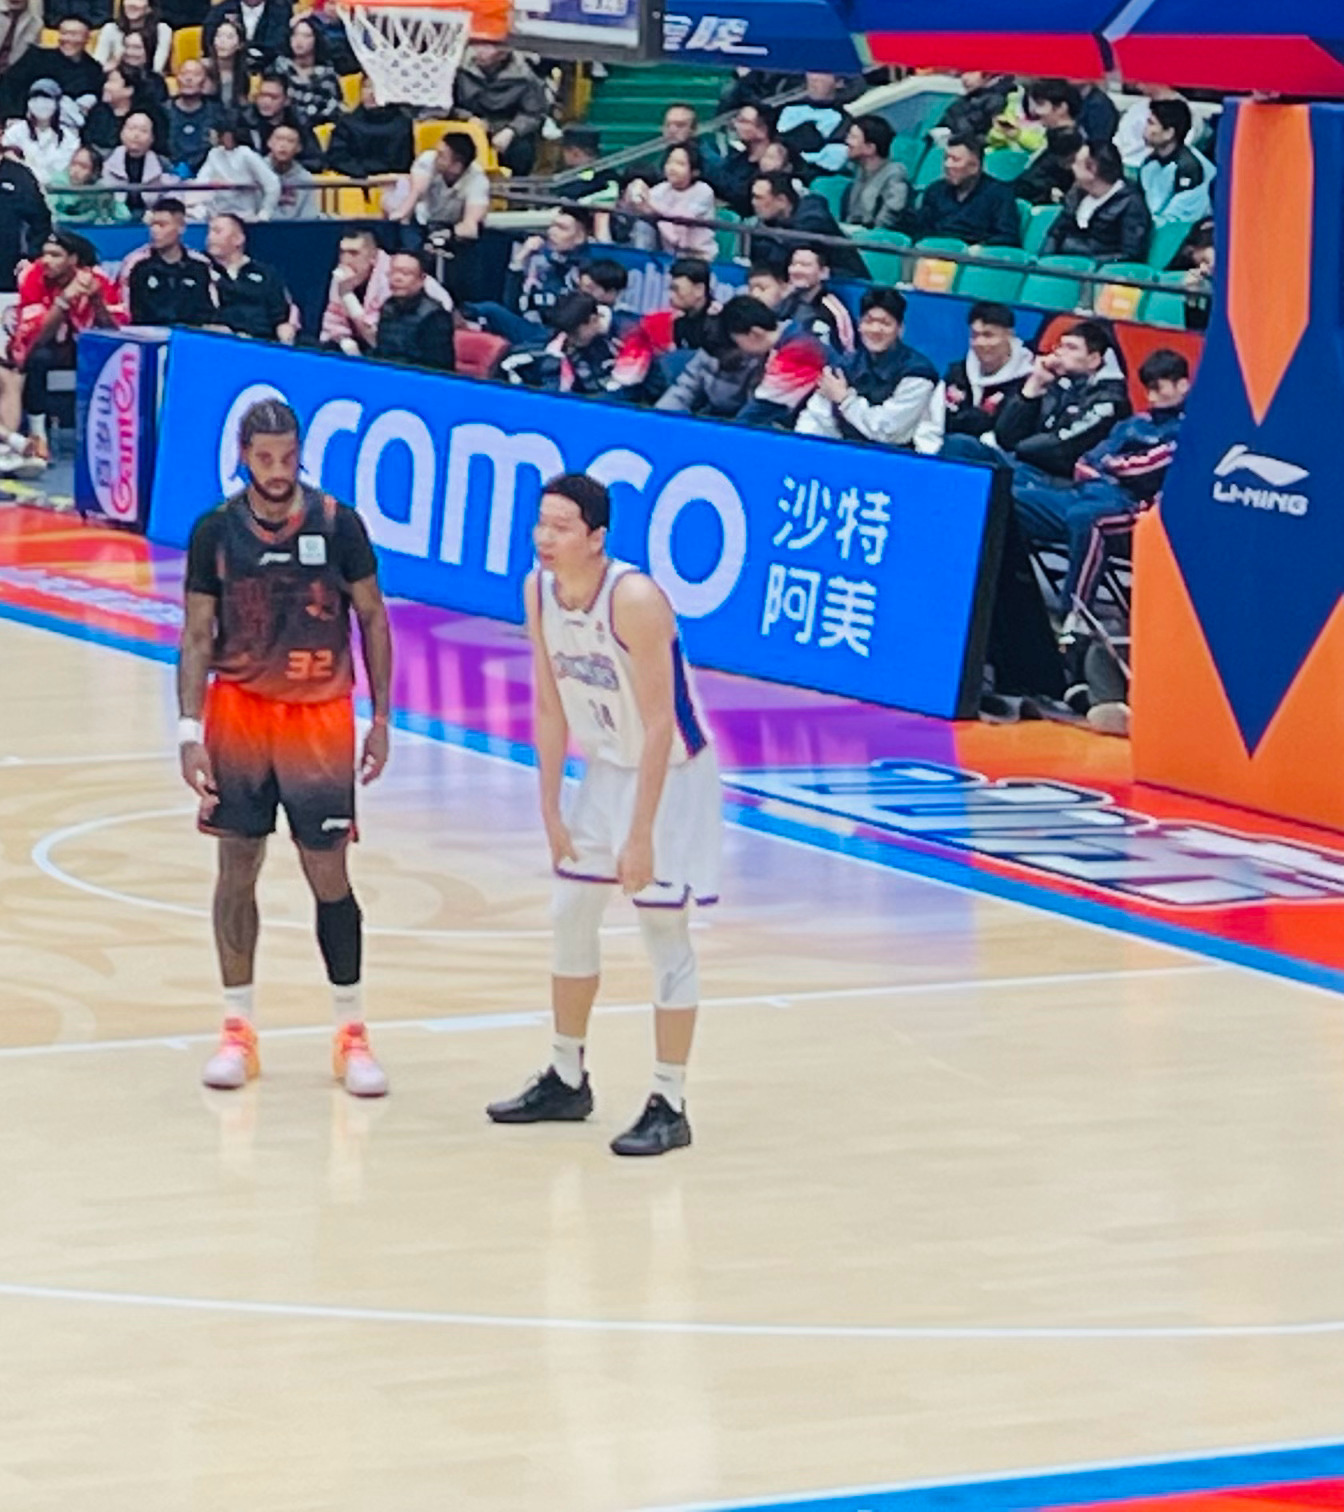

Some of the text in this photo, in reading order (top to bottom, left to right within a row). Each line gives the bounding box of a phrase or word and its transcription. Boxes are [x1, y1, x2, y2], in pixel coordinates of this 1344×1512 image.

[772, 475, 892, 566] 沙特
[761, 561, 879, 658] 阿美
[285, 649, 335, 681] 32
